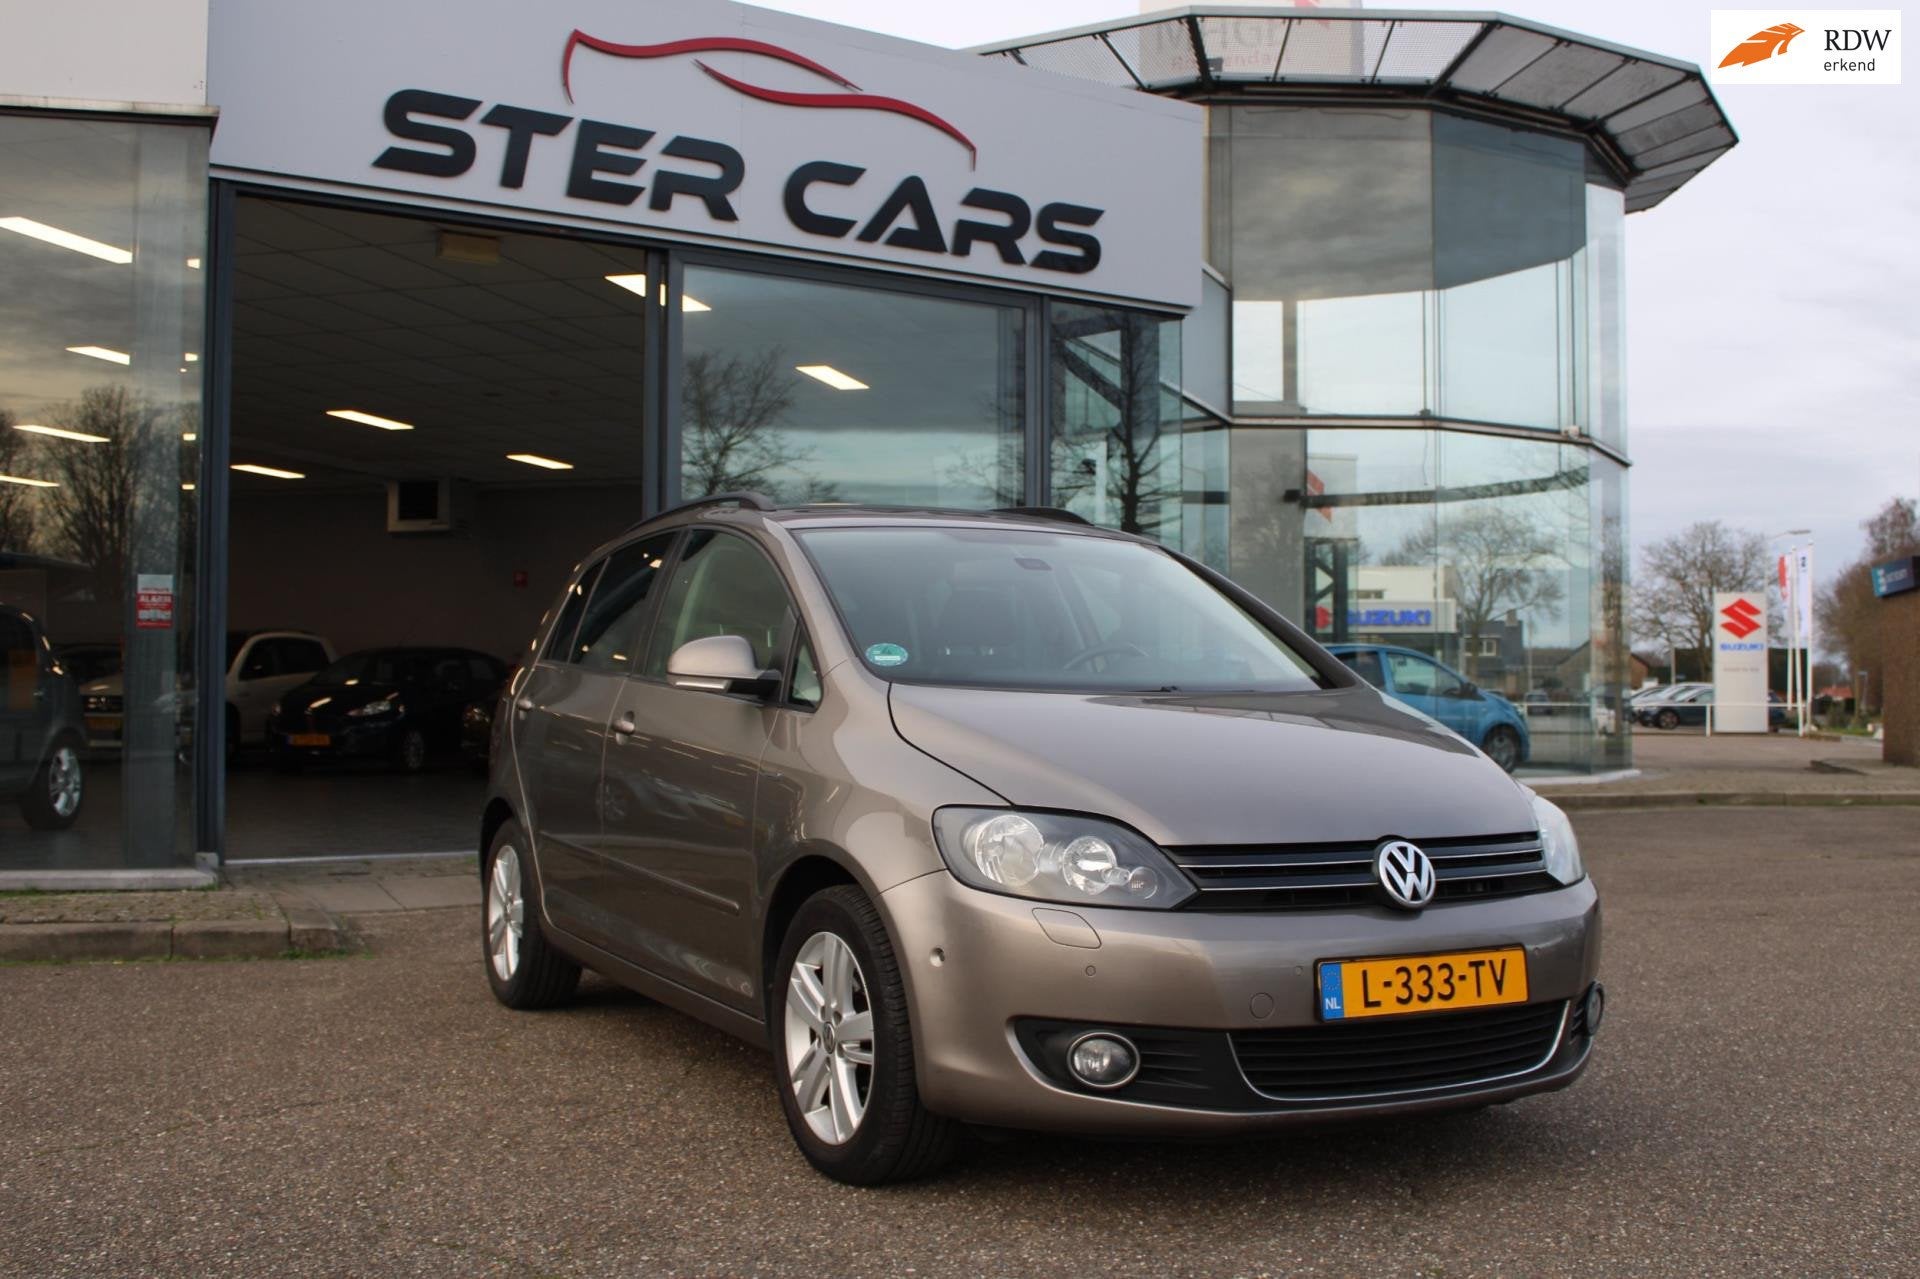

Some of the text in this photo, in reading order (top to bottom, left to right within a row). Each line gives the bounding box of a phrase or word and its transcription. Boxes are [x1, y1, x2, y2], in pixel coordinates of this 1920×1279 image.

[372, 88, 1105, 274] STER CARS
[1325, 958, 1507, 1010] NL L-333-TV
